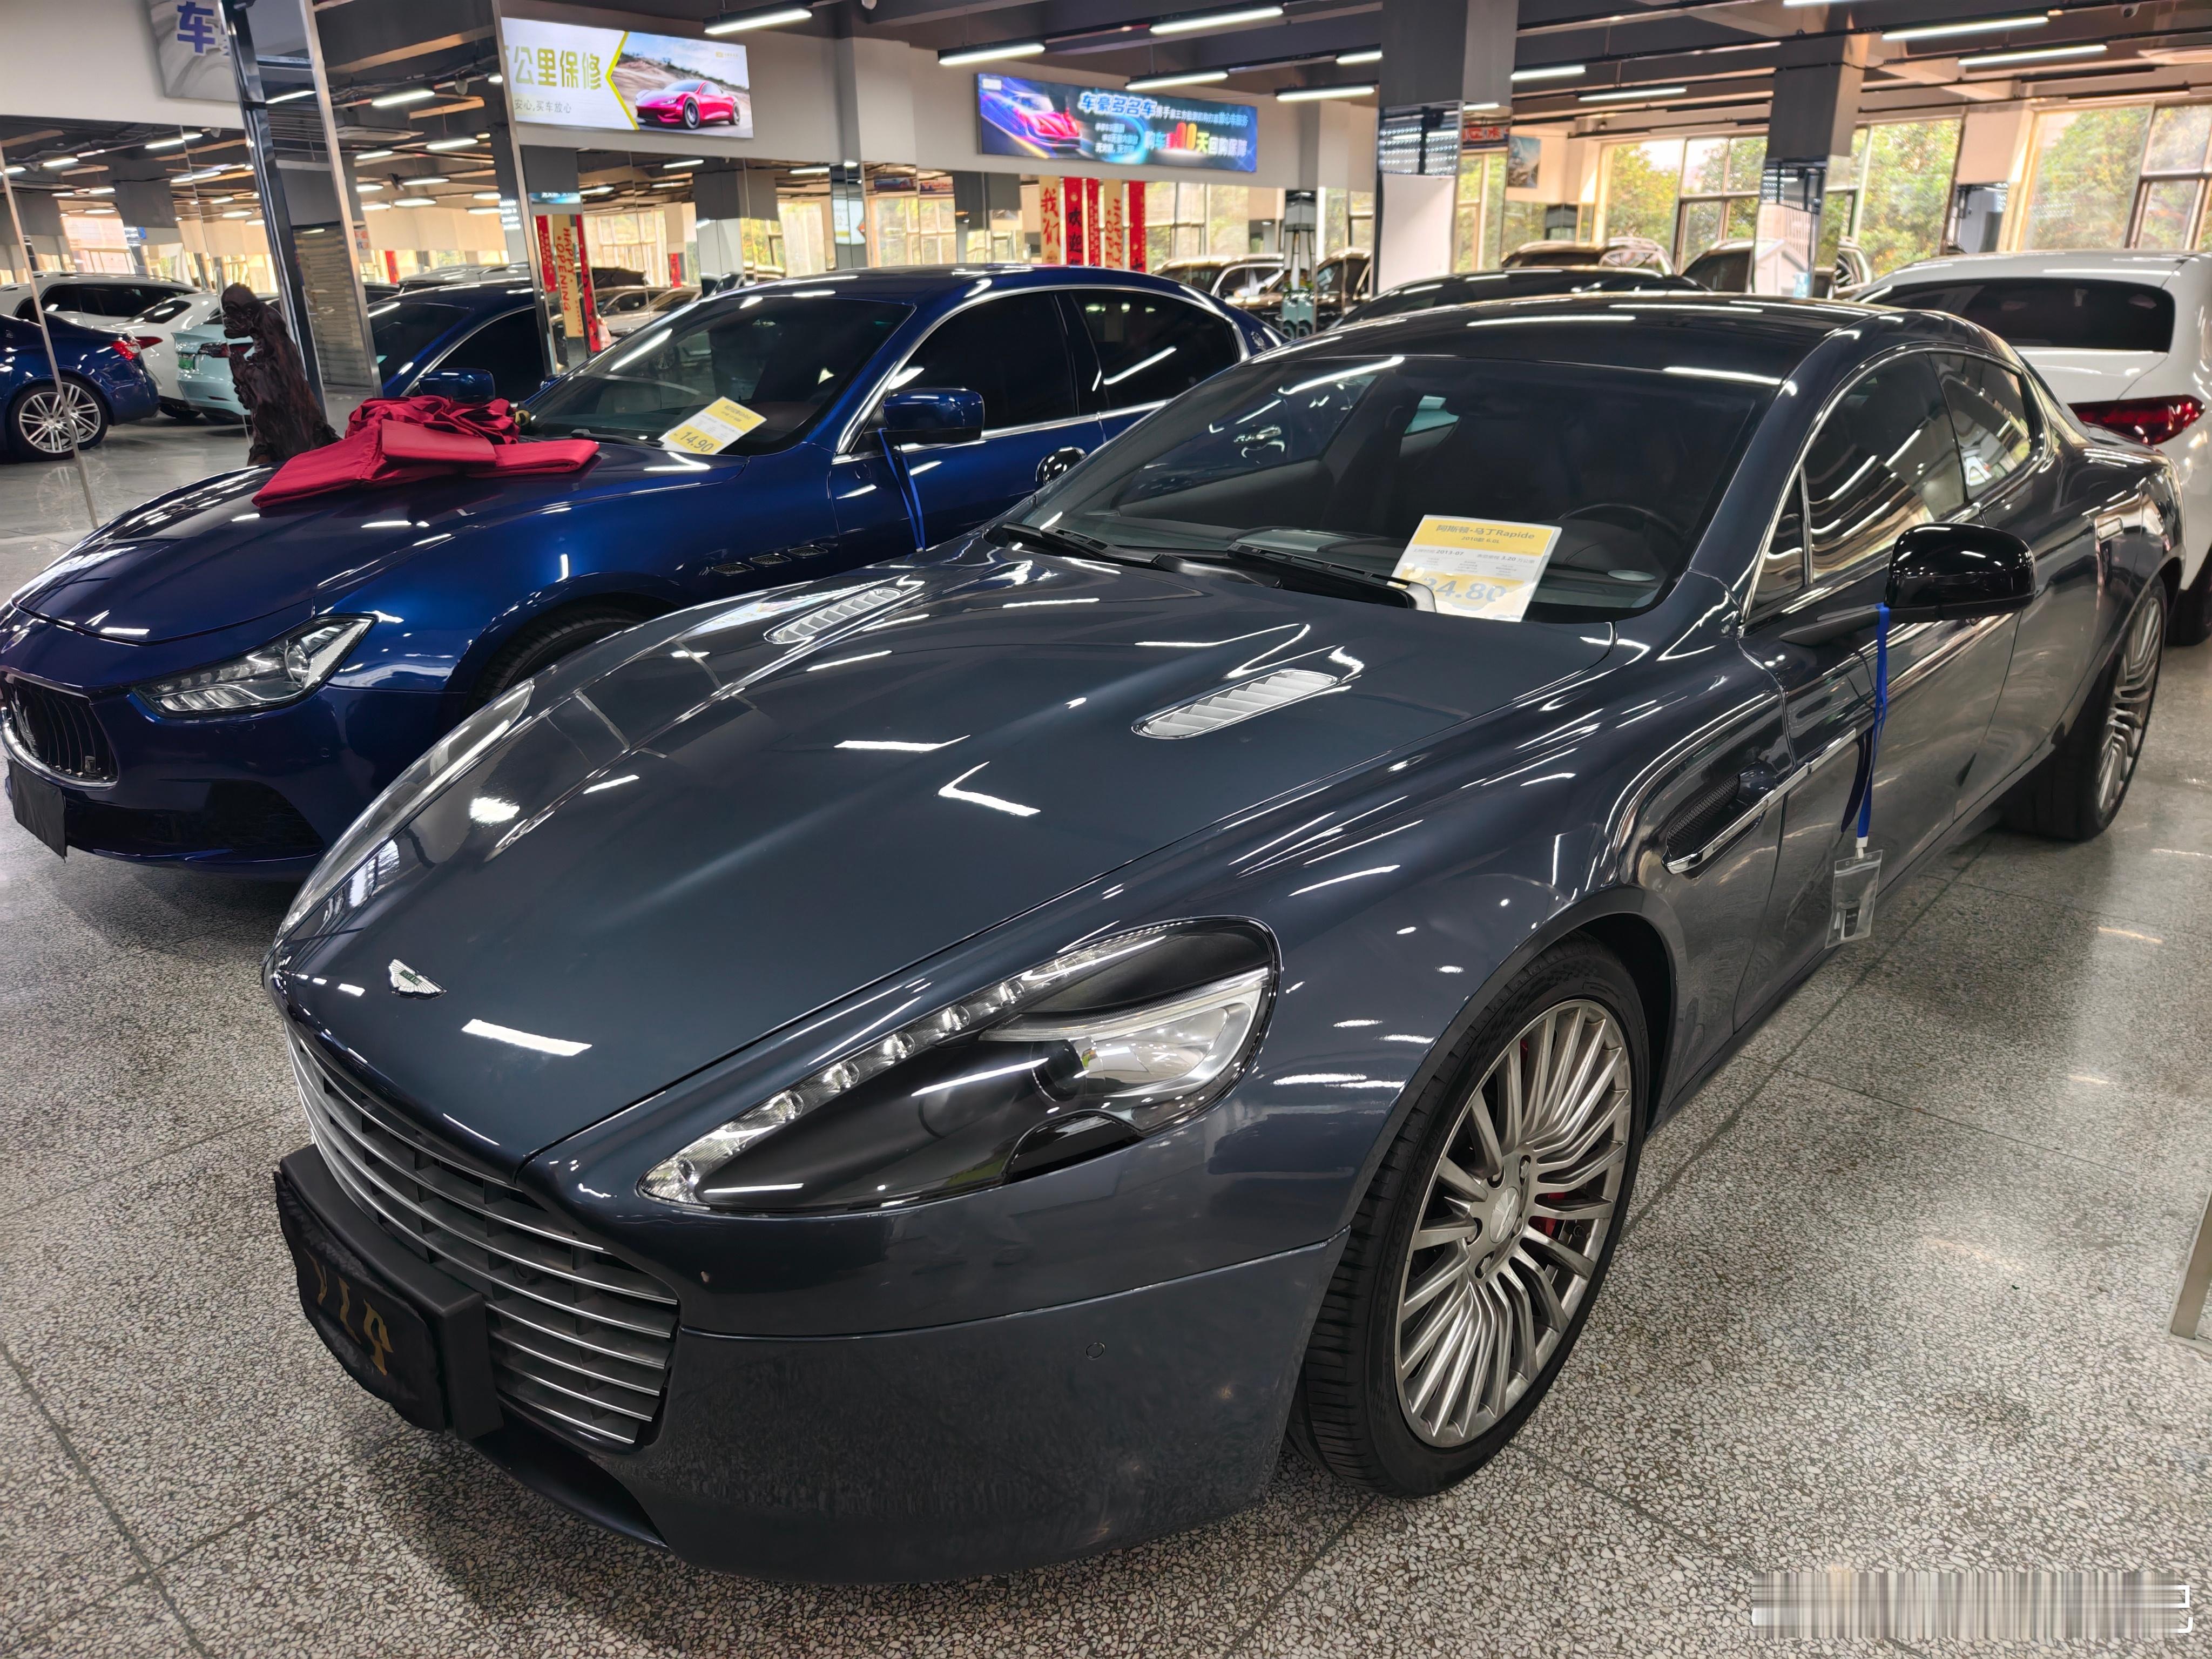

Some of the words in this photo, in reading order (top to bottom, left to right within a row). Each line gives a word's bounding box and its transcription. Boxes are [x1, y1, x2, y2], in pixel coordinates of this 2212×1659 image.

[177, 1, 230, 56] 车
[504, 45, 602, 90] 公里保修
[556, 244, 571, 312] OPENING
[679, 431, 714, 453] 14.90
